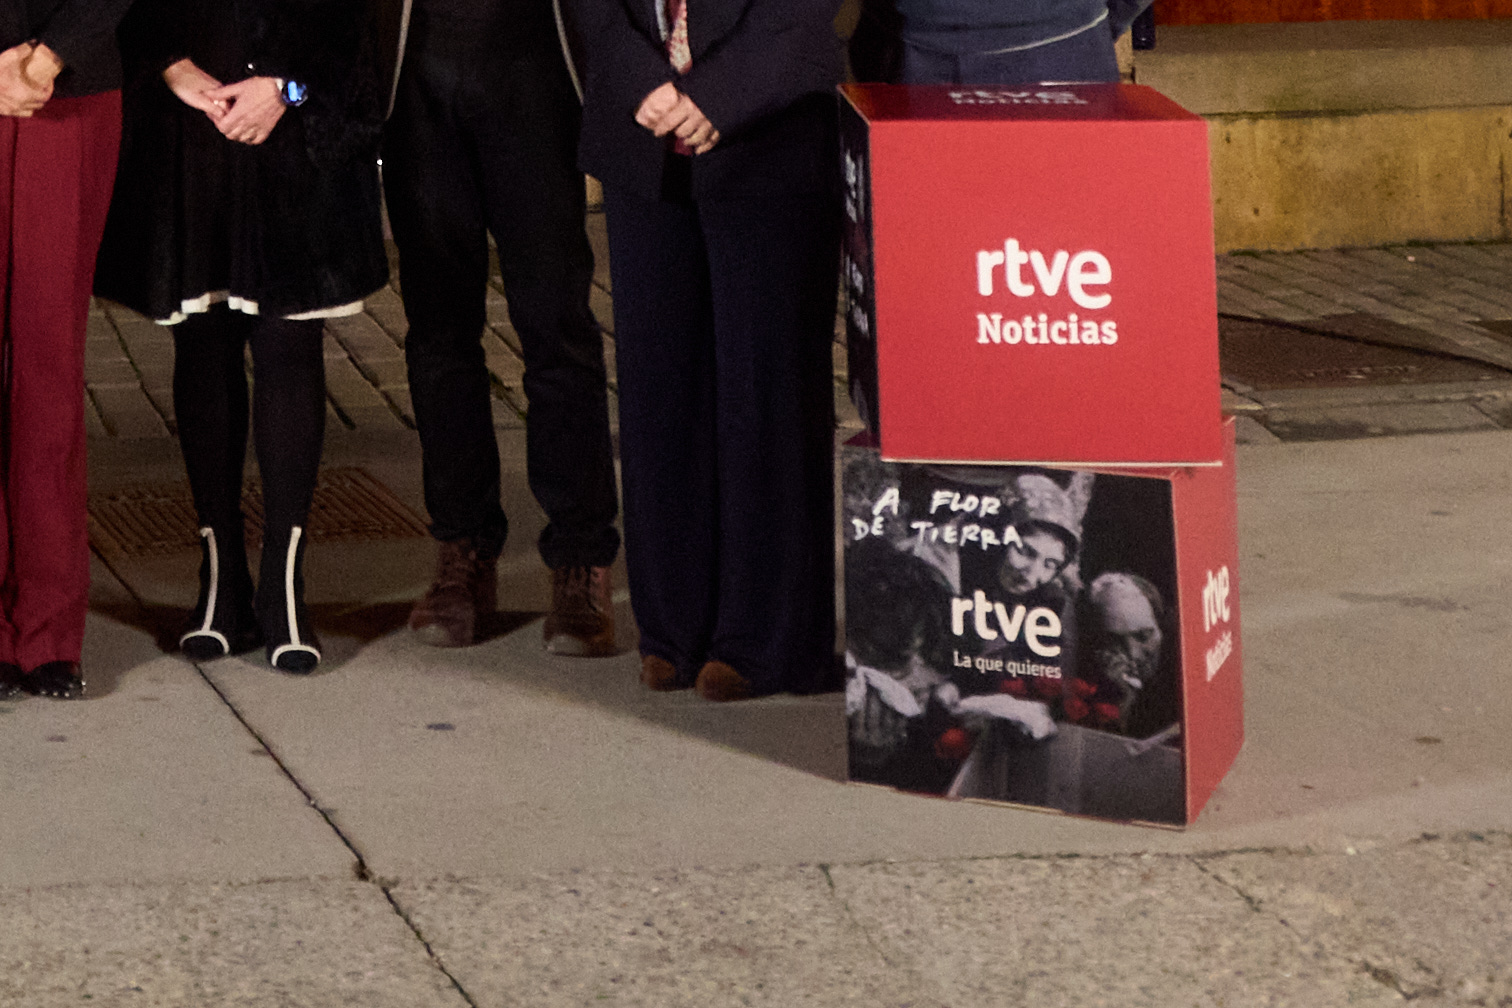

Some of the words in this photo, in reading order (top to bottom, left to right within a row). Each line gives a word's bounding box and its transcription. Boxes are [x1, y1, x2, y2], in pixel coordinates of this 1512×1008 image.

[976, 238, 1112, 309] rtve
[977, 313, 1118, 346] Noticias
[872, 486, 900, 516] A
[929, 489, 1001, 518] FLOR
[851, 516, 885, 541] DE
[910, 520, 1024, 551] TIERRA
[1203, 564, 1231, 634] rtve
[951, 589, 1063, 658] rtve
[953, 650, 972, 669] La
[975, 657, 1004, 674] que
[1006, 659, 1062, 680] quieres
